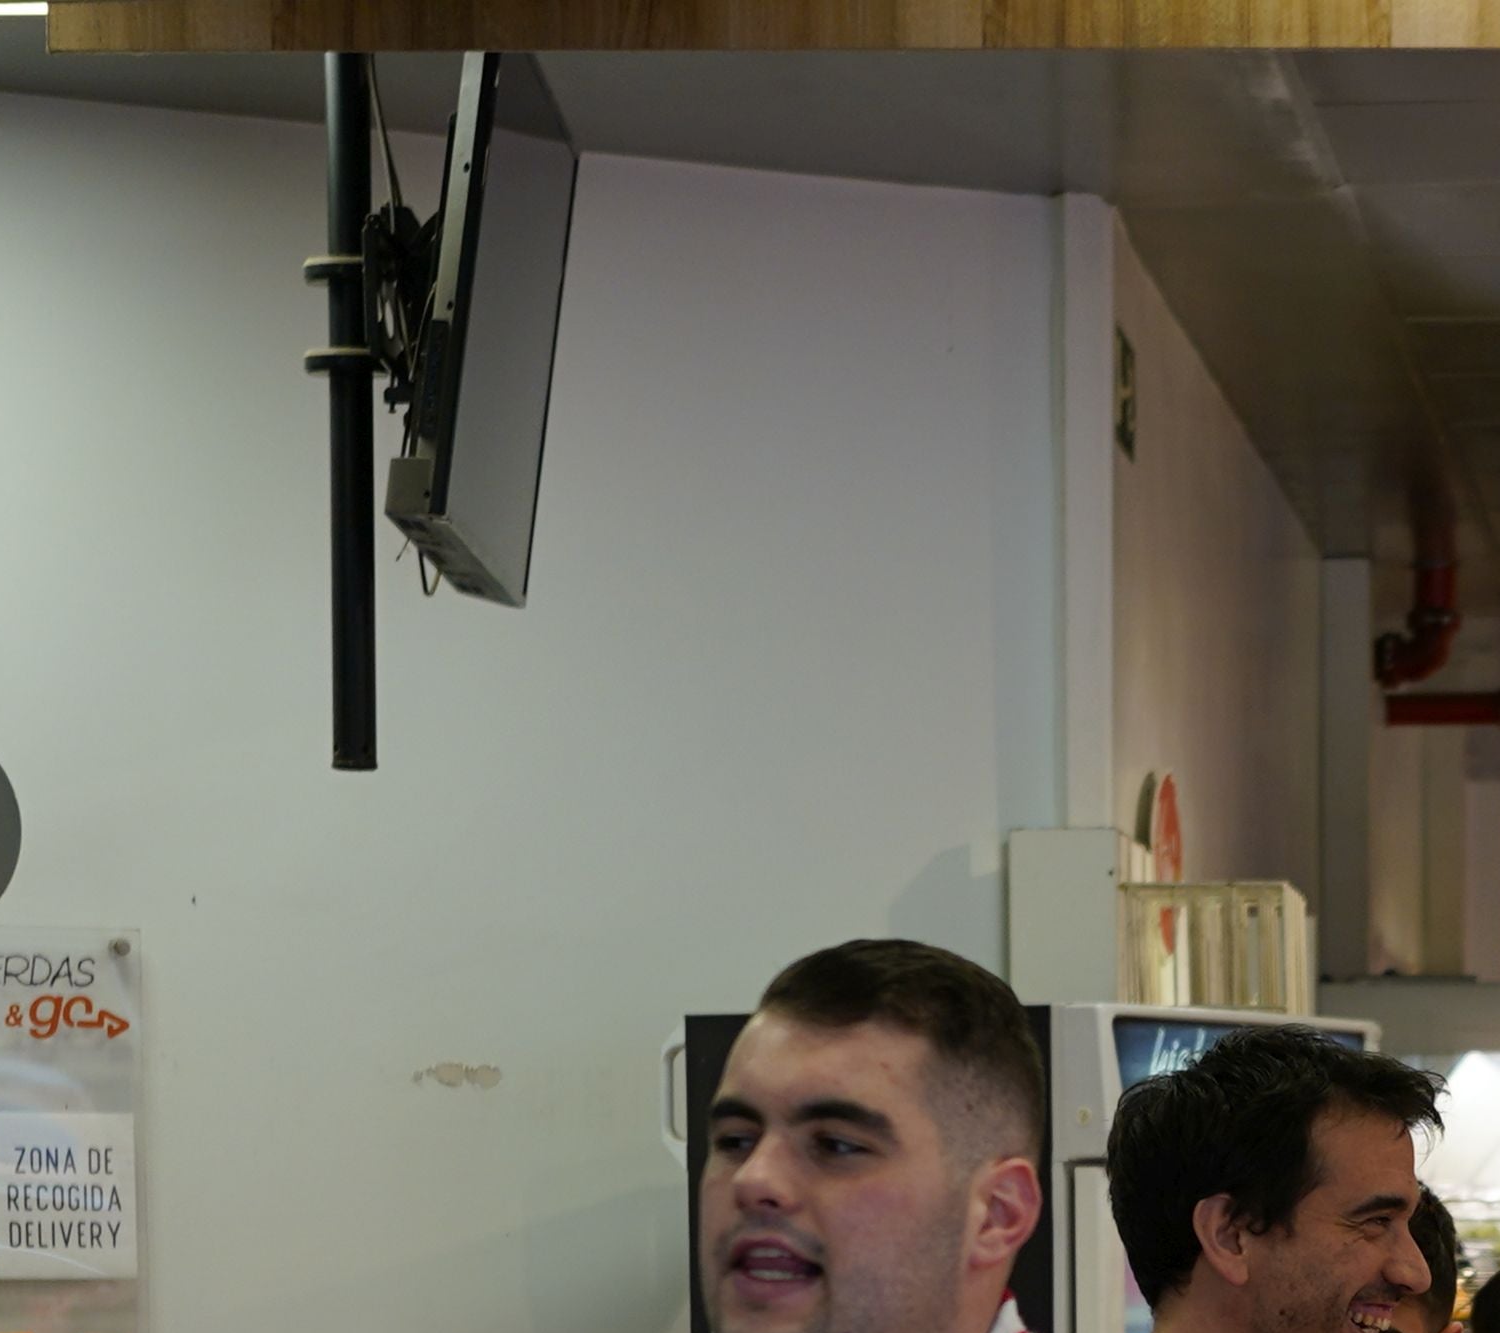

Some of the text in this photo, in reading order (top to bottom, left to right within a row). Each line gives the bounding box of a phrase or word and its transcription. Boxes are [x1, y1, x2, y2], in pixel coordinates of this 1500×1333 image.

[14, 1147, 113, 1175] ZONA DE
[7, 1184, 123, 1213] RECOGIDA
[8, 1221, 122, 1249] DELIVERY
